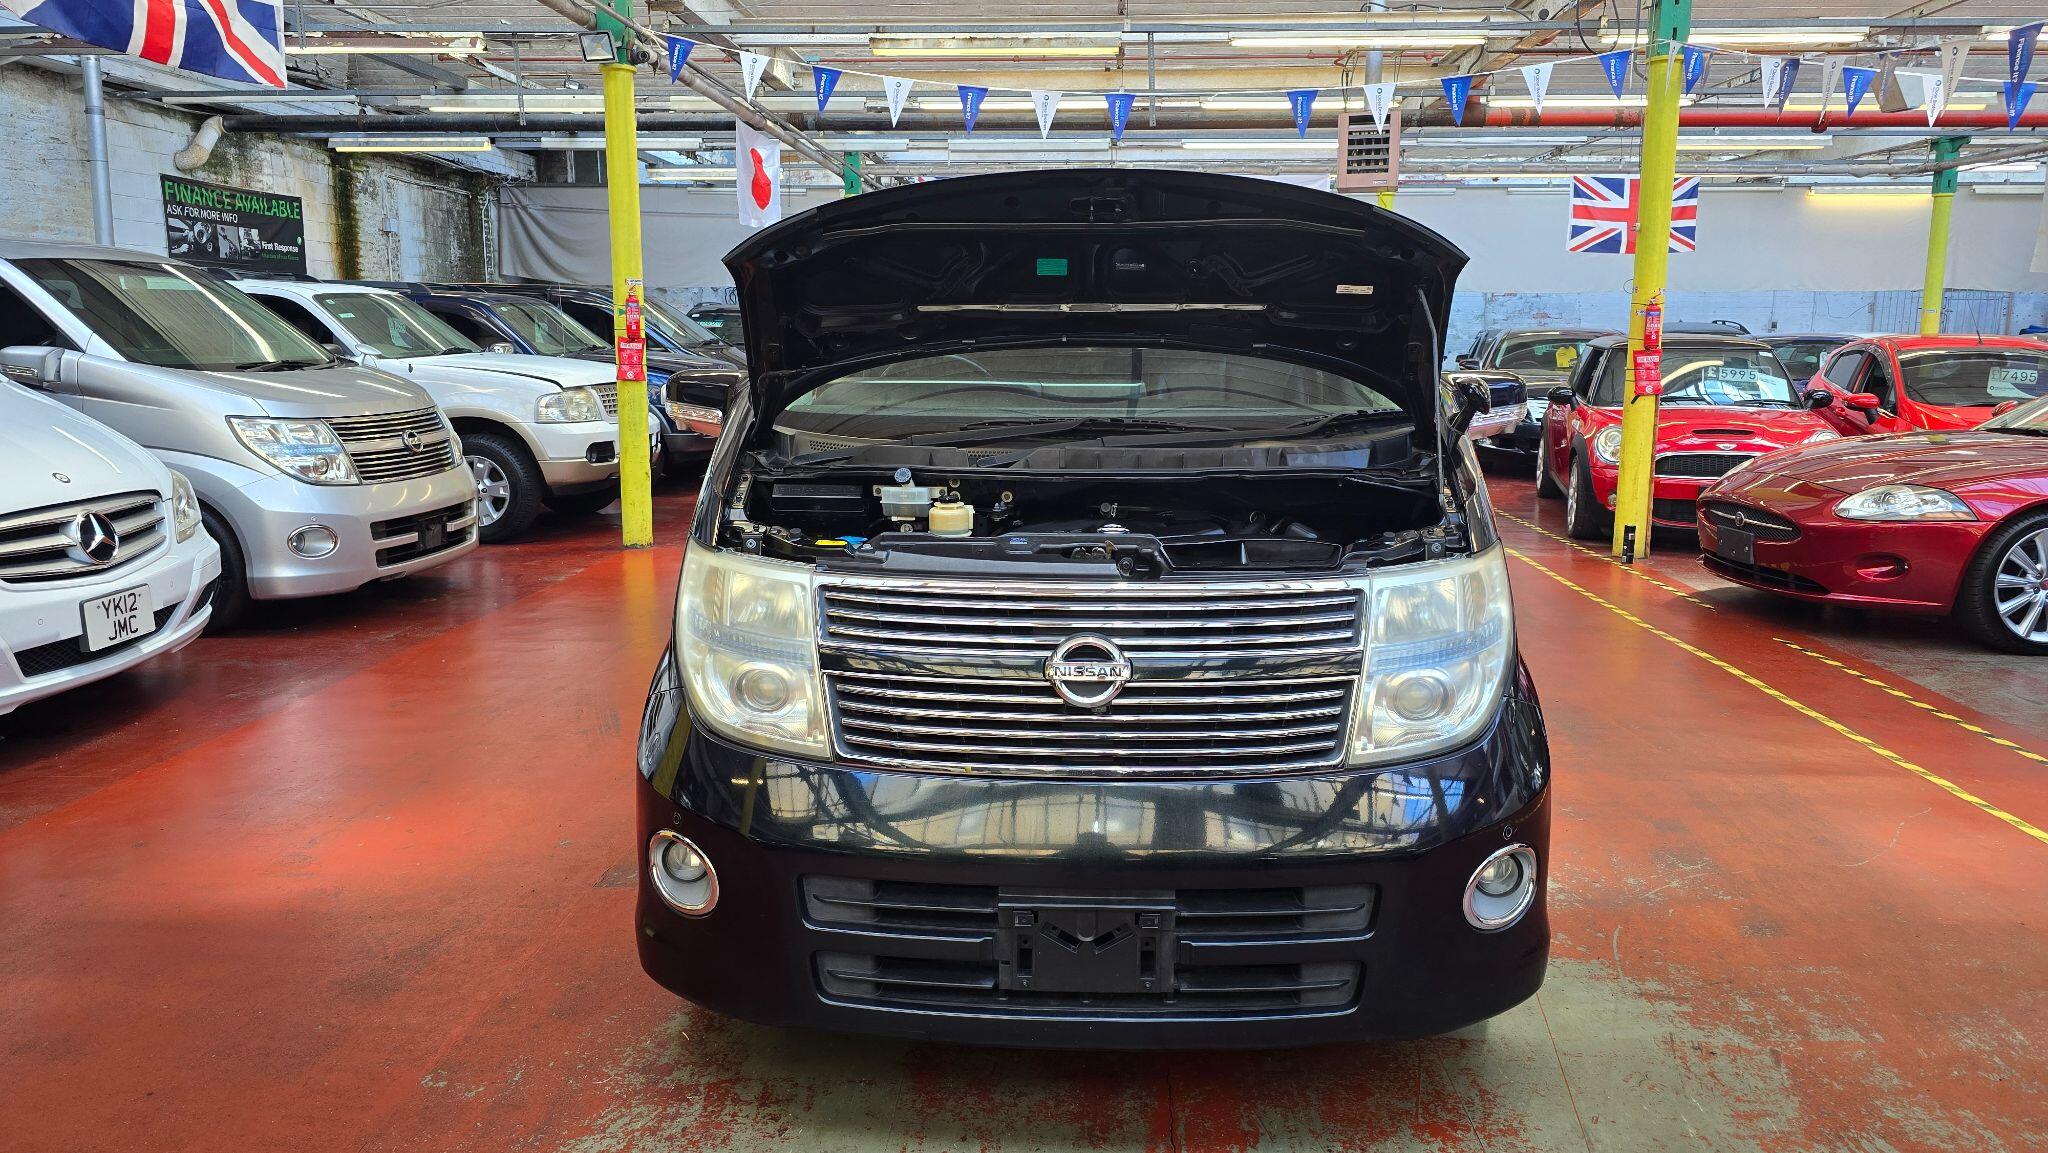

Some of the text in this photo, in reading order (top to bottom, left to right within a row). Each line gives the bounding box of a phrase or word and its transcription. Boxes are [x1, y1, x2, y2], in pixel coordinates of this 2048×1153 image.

[2012, 38, 2025, 70] Finance
[165, 181, 300, 219] FINANCE AVAILABLE
[167, 204, 238, 223] ASK FOR MORE INFO
[262, 240, 299, 253] First Response
[102, 592, 138, 619] YK12
[109, 615, 138, 640] JMC
[1054, 666, 1121, 677] NISSAN
